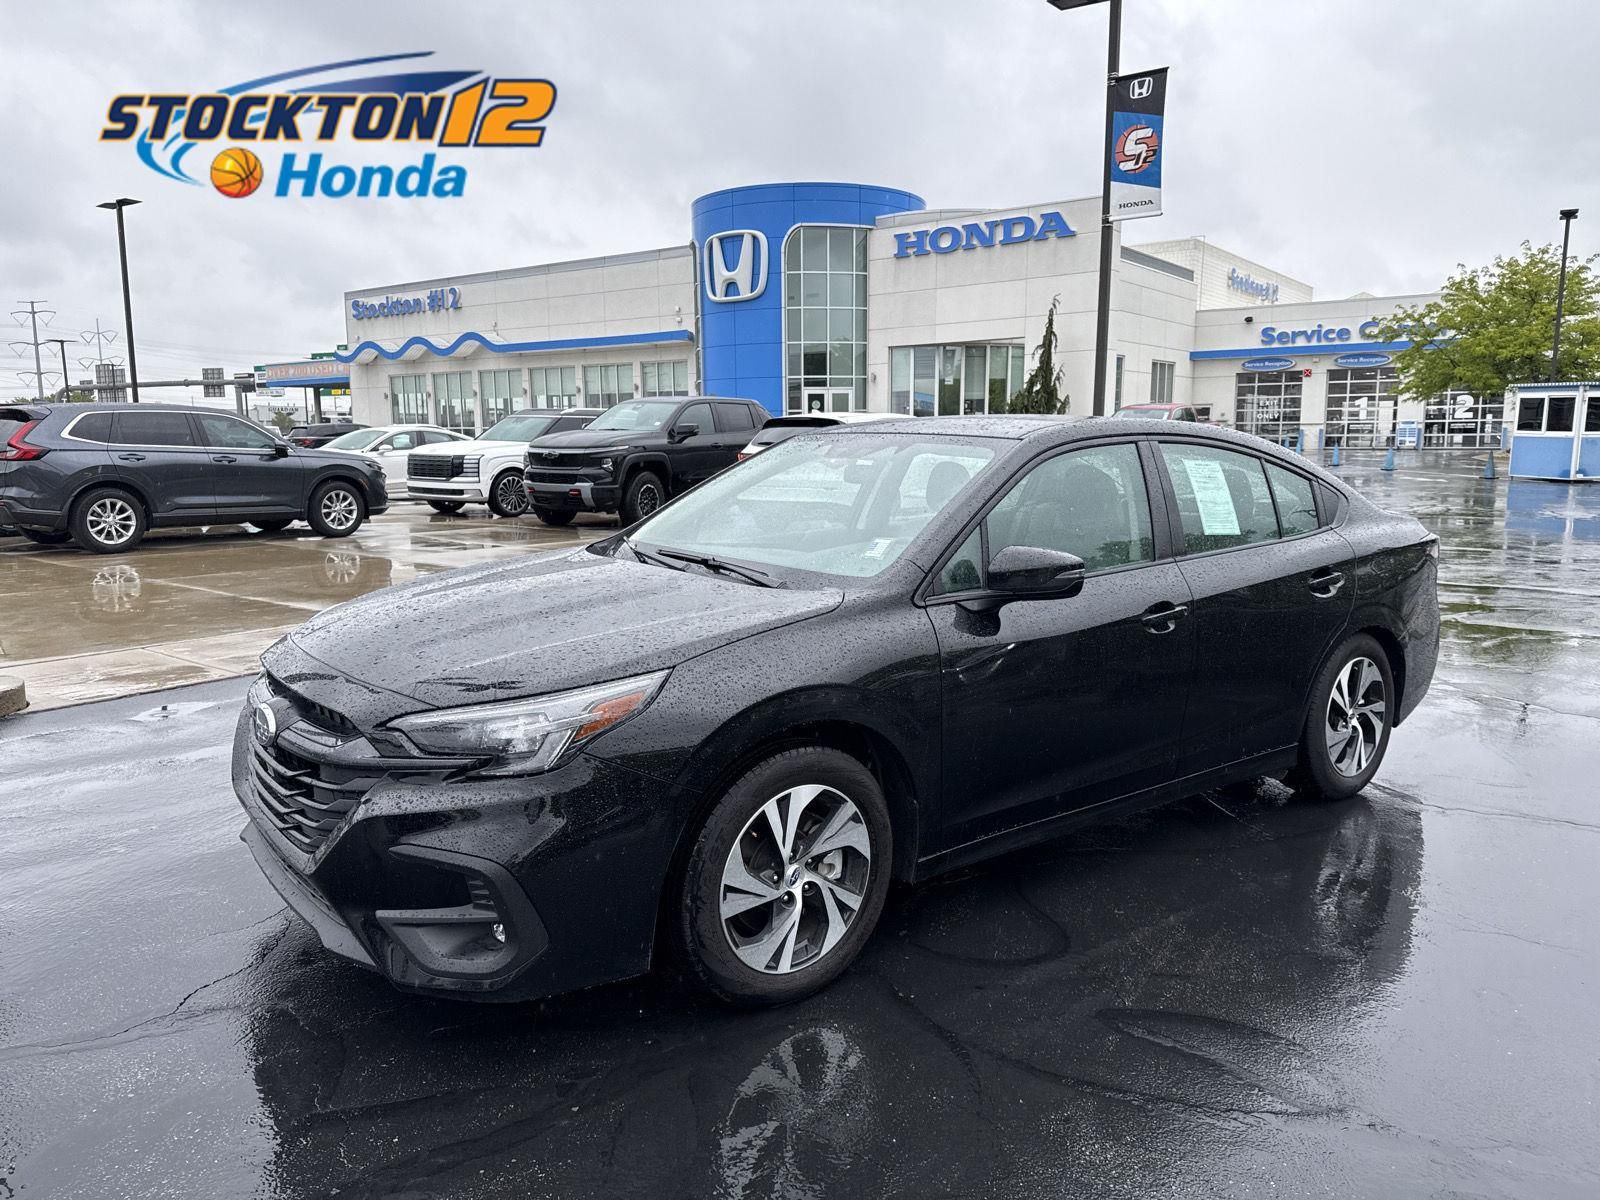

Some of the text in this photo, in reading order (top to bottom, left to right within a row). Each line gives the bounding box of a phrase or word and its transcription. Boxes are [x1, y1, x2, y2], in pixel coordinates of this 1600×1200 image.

[1118, 200, 1154, 209] HONDA
[894, 211, 1077, 258] HONDA
[351, 287, 461, 320] Stockton #12
[1261, 324, 1350, 345] Service
[1354, 397, 1368, 419] 1
[1454, 395, 1474, 418] 2
